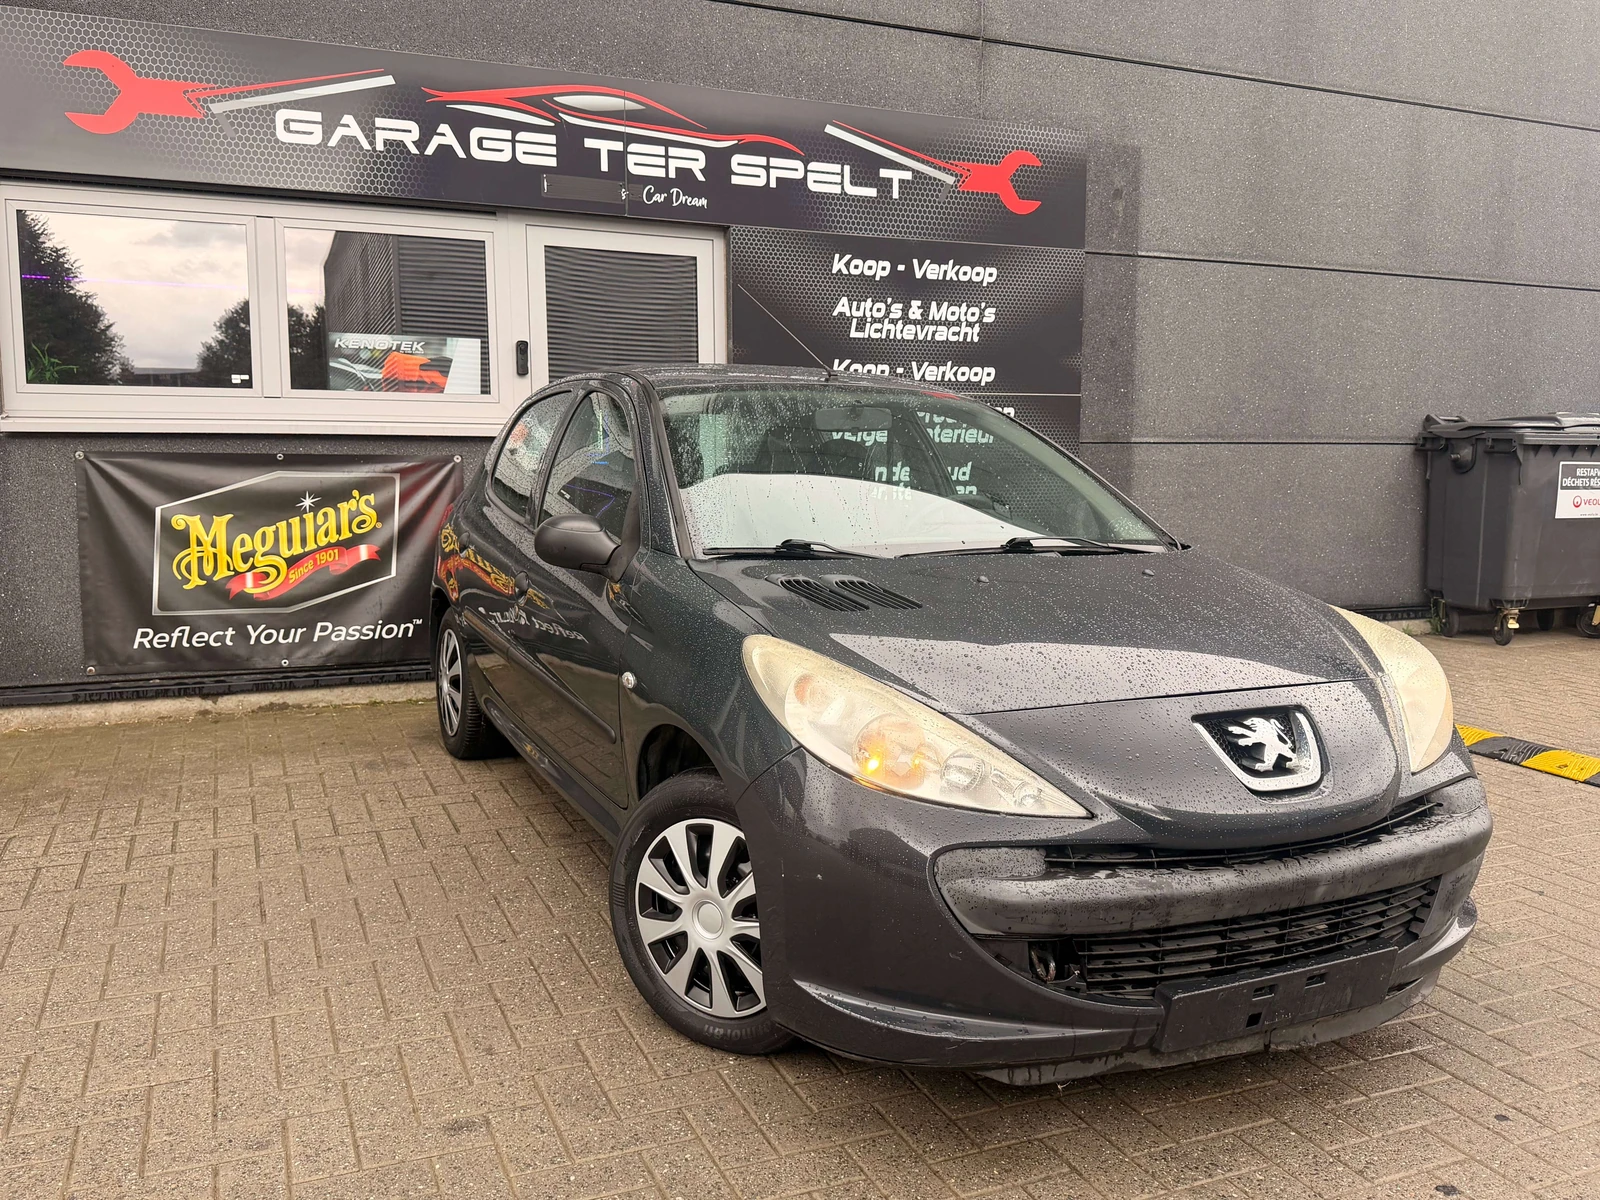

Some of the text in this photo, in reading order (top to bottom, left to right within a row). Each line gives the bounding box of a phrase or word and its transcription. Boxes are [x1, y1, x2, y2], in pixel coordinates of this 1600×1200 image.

[275, 109, 912, 199] GARAGE TER SPELT
[642, 184, 668, 206] Car
[670, 187, 708, 210] Dream
[832, 253, 891, 281] Koop
[912, 258, 998, 286] Verkoop
[832, 297, 996, 323] Auto's & Moto's
[850, 318, 980, 342] Lichtevracht
[334, 338, 426, 352] KENOTEK
[911, 361, 996, 386] Verkoop
[1562, 476, 1590, 487] DÉCHETS
[171, 489, 378, 594] Meguiar's
[288, 548, 339, 584] Since 1901
[132, 625, 236, 649] Reflect
[246, 624, 307, 645] Your
